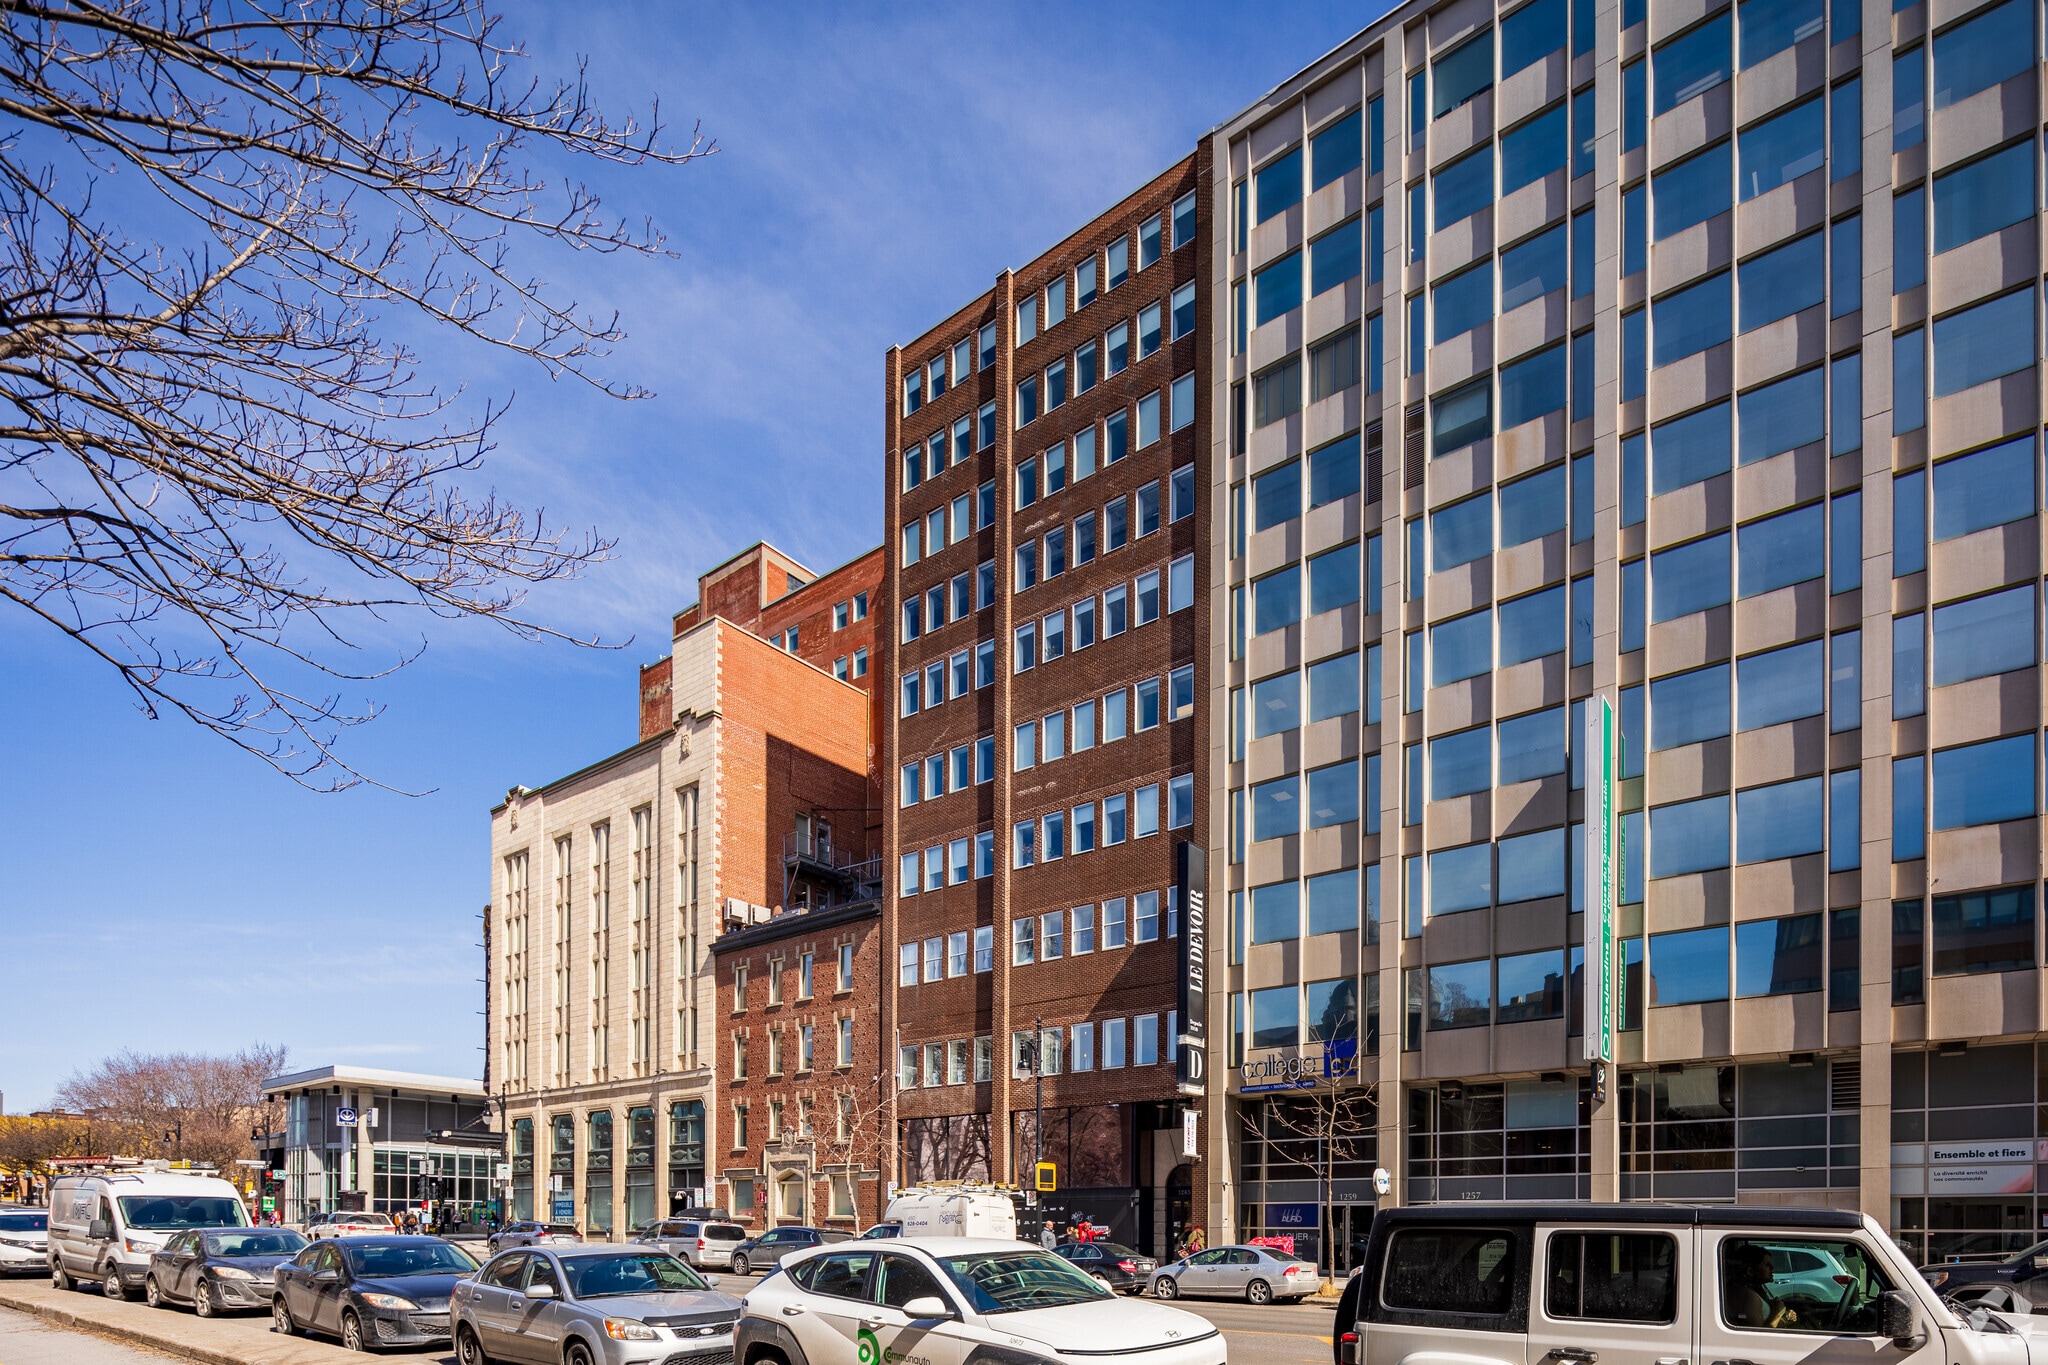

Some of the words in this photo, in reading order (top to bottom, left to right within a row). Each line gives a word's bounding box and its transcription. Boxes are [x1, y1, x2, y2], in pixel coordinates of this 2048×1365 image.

[1190, 889, 1204, 966] DEVOIR
[1190, 965, 1203, 994] LE
[1190, 1050, 1202, 1079] D
[1240, 1052, 1315, 1081] collège
[1934, 1150, 1985, 1159] Ensemble
[2002, 1149, 2026, 1157] fiers
[1461, 1191, 1481, 1199] 1257
[884, 1346, 931, 1365] Communauto
